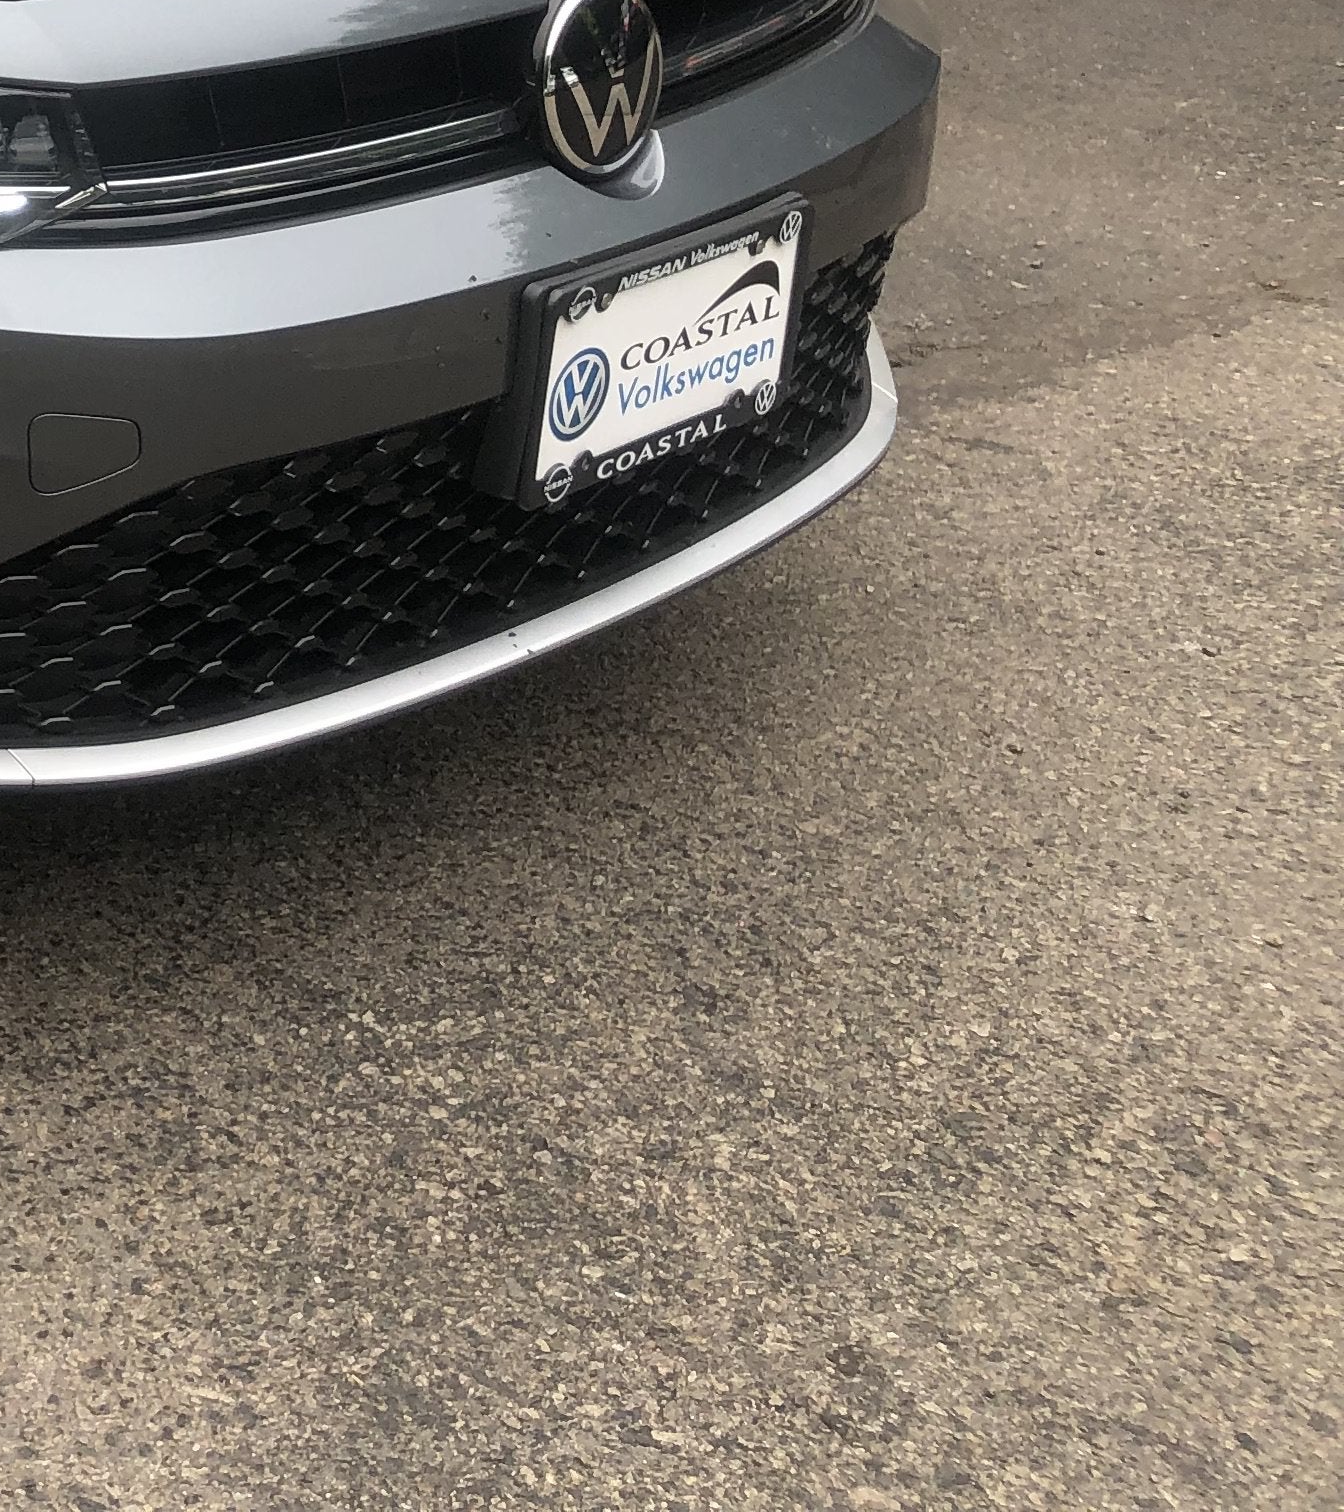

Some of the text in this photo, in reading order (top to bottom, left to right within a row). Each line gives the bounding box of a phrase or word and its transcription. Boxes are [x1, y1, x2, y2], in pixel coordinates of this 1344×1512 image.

[618, 230, 760, 292] NISSAN Volkswagen
[619, 296, 780, 371] COASTAL
[618, 337, 774, 416] Volkswagen
[596, 414, 727, 480] COASTAL
